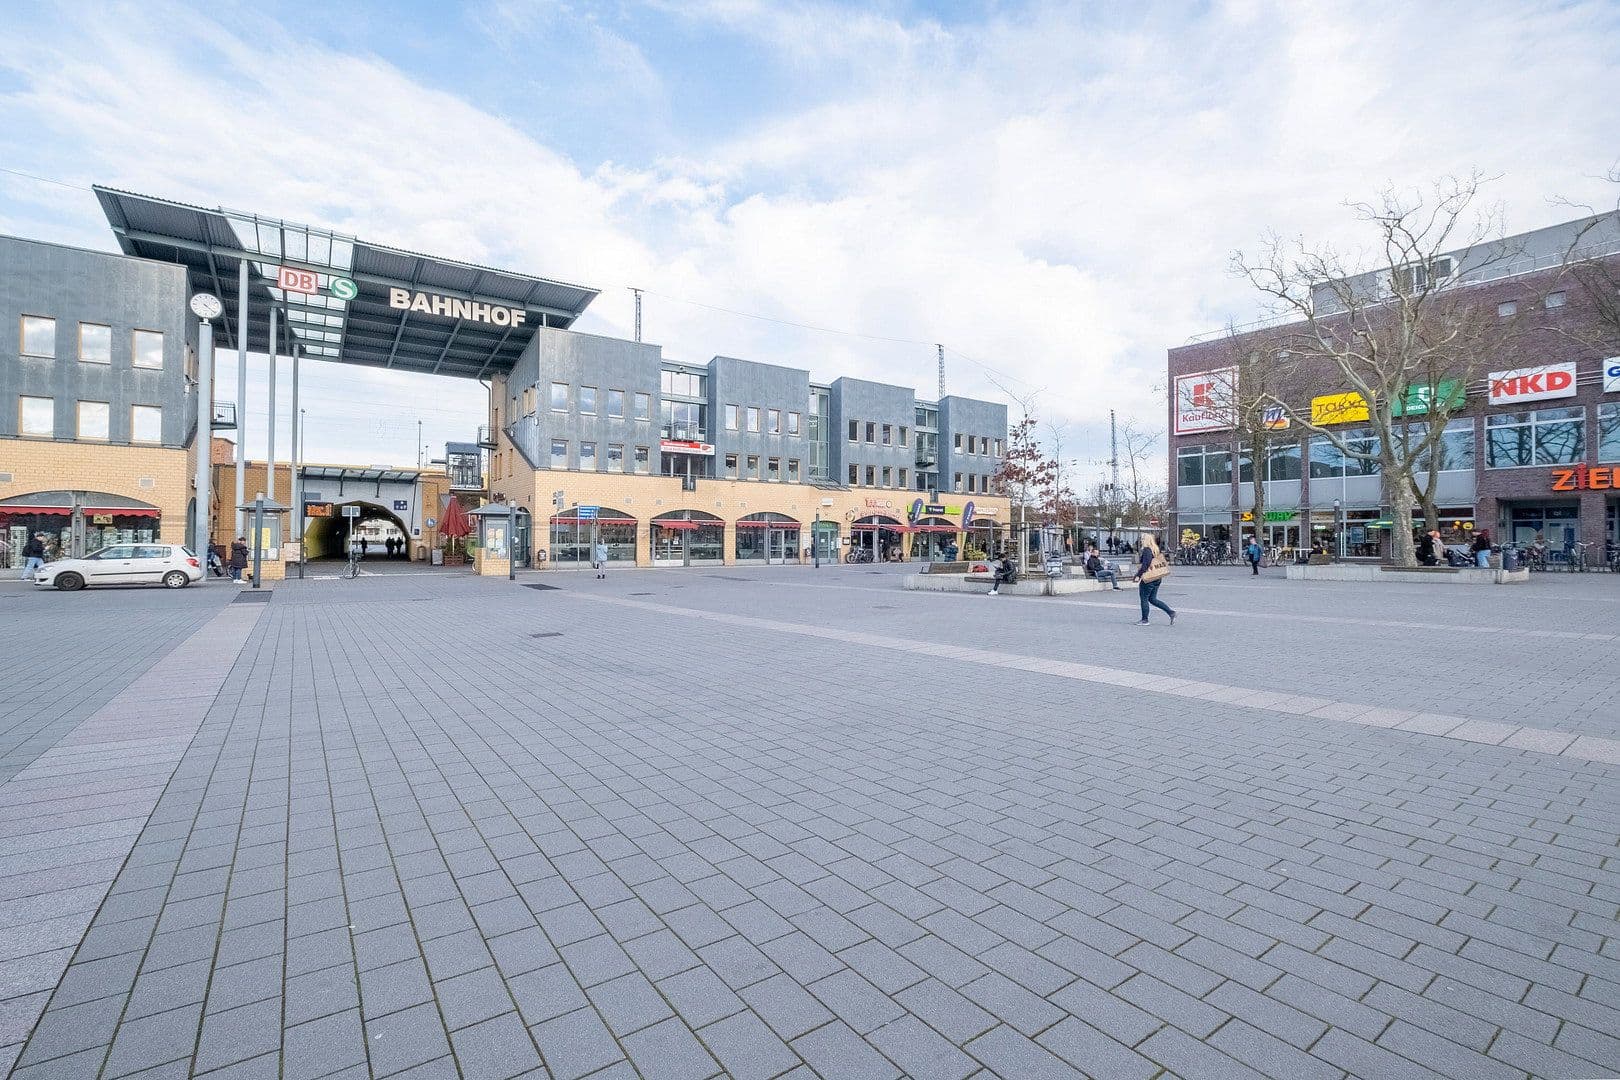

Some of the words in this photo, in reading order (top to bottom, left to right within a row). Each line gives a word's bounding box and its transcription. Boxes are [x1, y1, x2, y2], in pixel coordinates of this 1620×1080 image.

[285, 271, 313, 290] DB
[335, 278, 353, 299] S
[390, 288, 526, 327] BAHNHOF
[1492, 371, 1572, 398] NKD
[1242, 511, 1292, 522] SWAY
